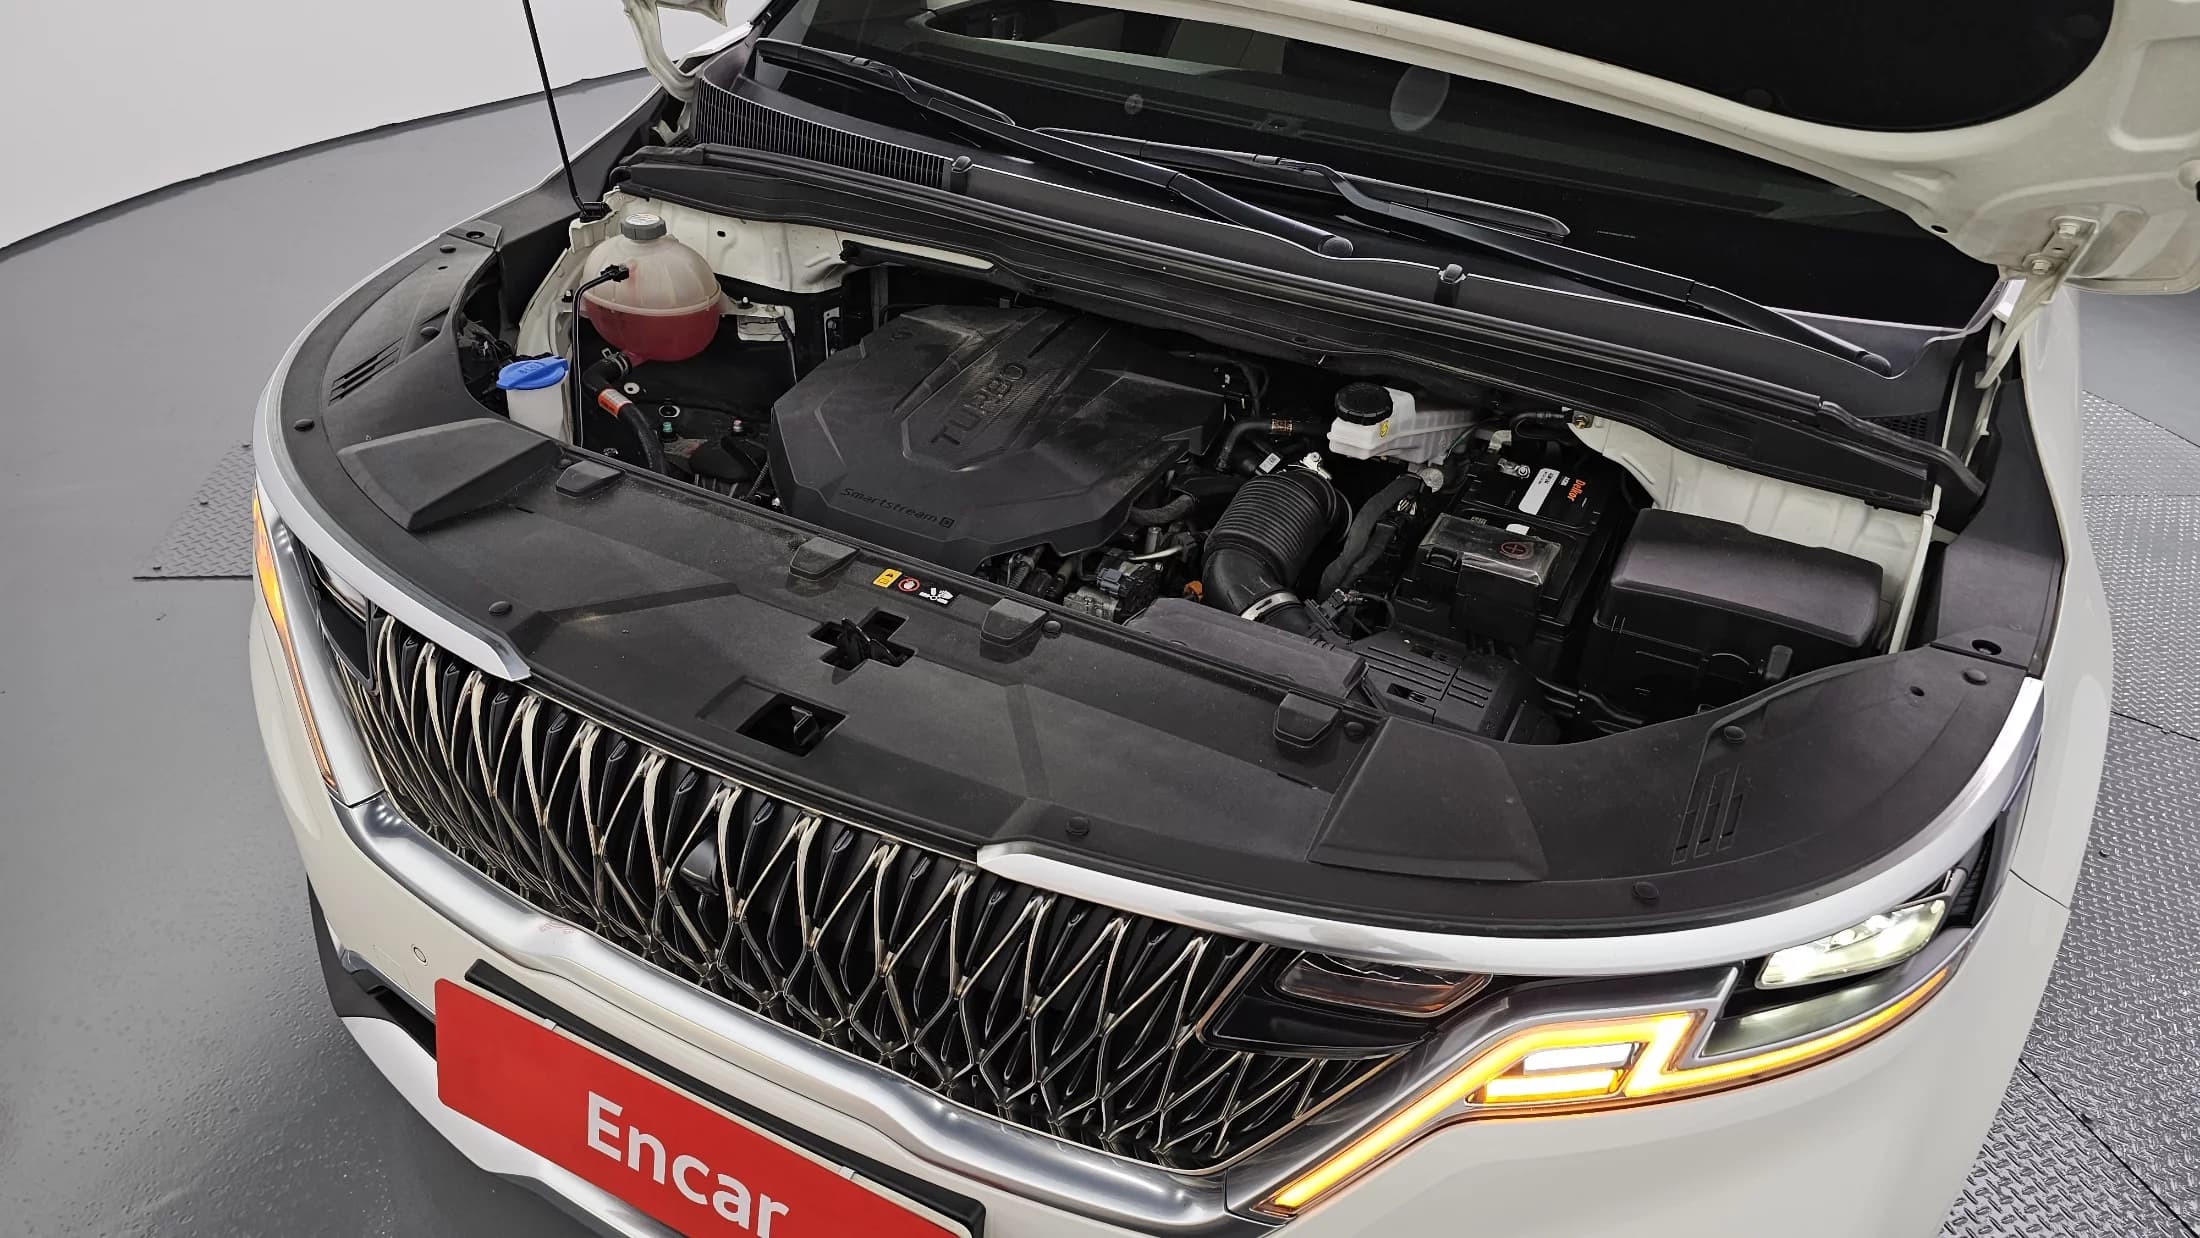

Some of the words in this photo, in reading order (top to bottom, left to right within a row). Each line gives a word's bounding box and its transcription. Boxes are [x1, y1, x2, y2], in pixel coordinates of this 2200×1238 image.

[930, 362, 1027, 446] TURBO
[840, 487, 938, 523] Smartstream
[1567, 479, 1586, 502] Delkor
[587, 1090, 790, 1238] Encar
